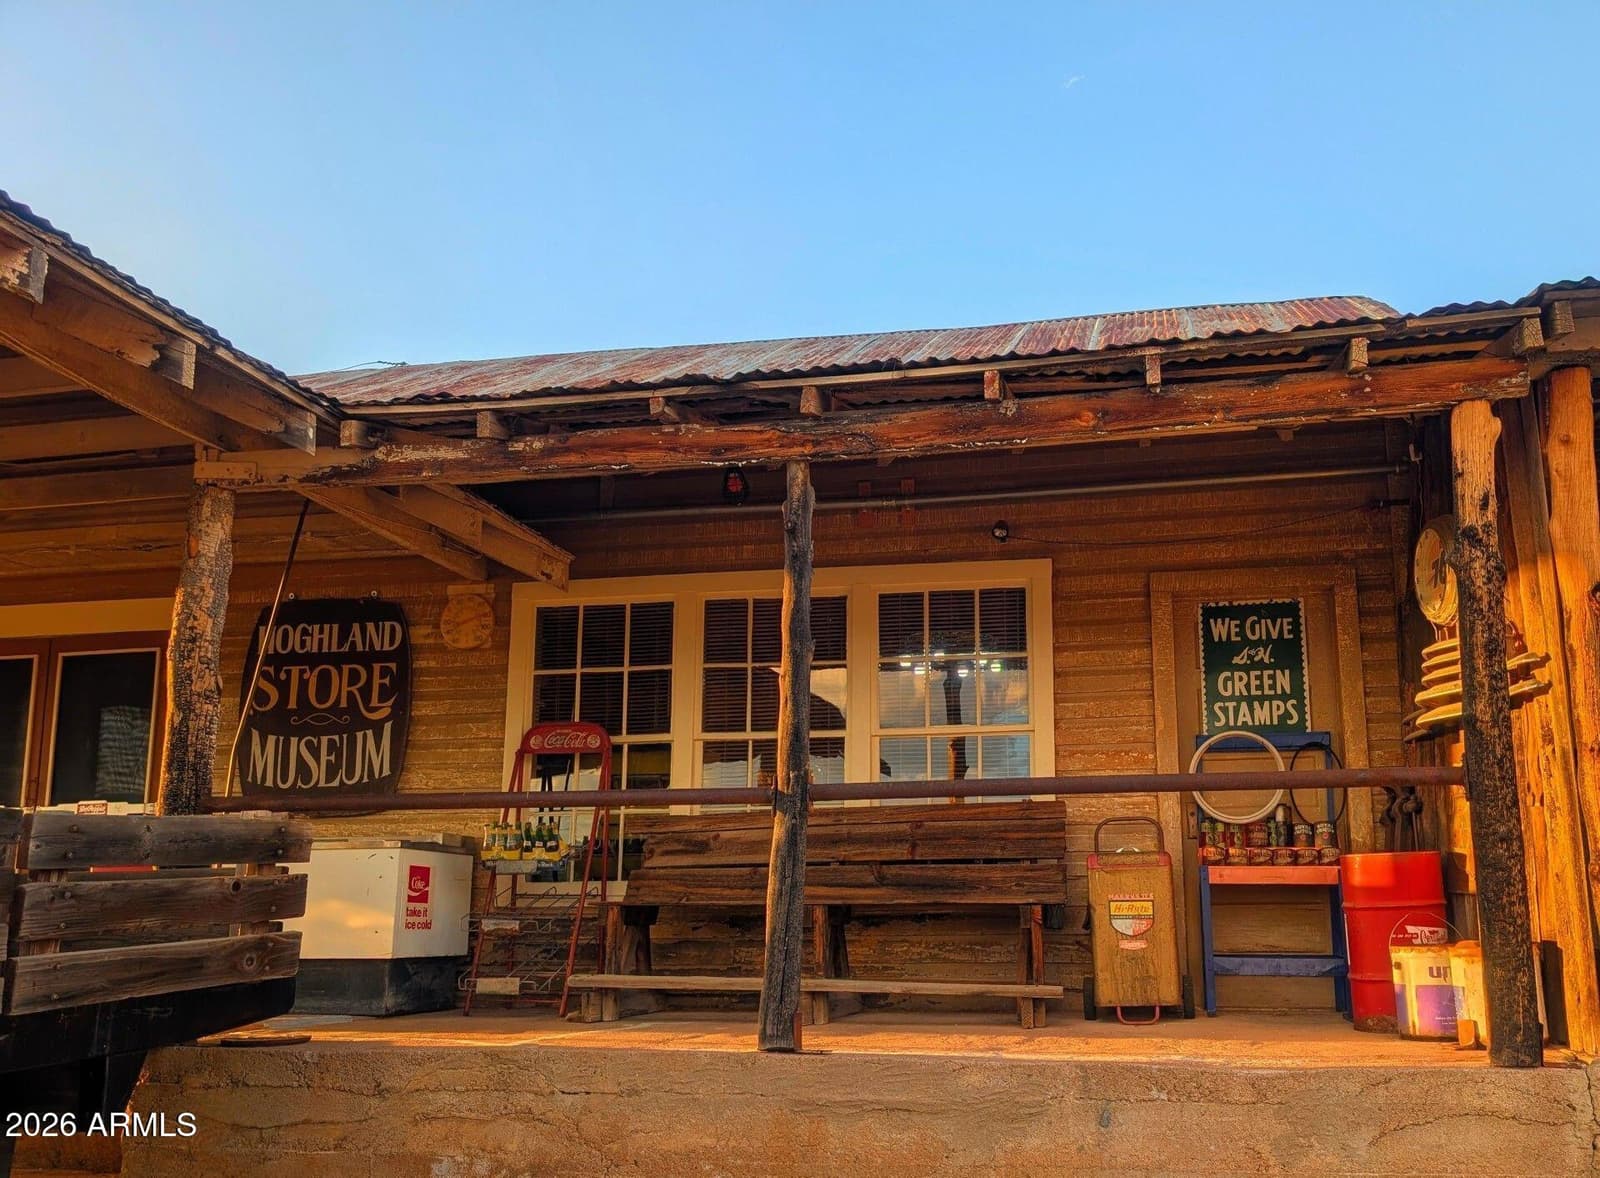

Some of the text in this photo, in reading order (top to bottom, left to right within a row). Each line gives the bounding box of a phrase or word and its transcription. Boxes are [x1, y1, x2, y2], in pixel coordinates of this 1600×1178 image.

[258, 621, 402, 655] HOGHLAND
[1209, 615, 1293, 642] WE GIVE
[251, 662, 399, 720] STORE
[1217, 669, 1291, 697] GREEN
[1213, 699, 1299, 727] STAMPS
[247, 720, 393, 789] MUSEUM
[405, 919, 432, 930] ice cold
[406, 907, 428, 917] take it
